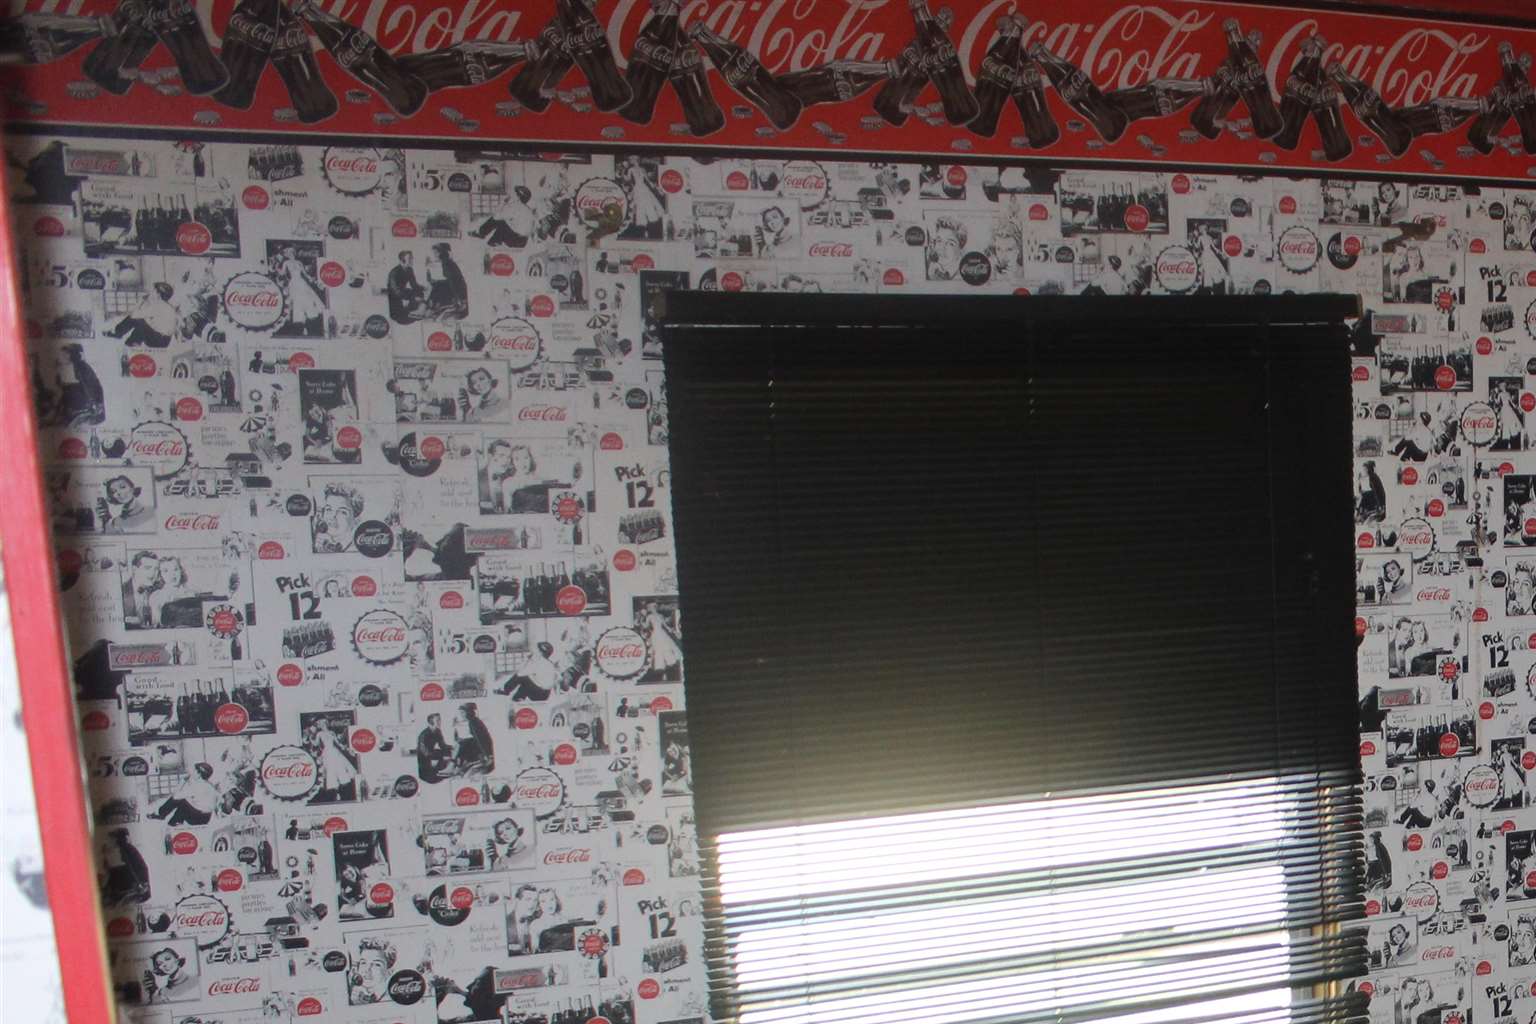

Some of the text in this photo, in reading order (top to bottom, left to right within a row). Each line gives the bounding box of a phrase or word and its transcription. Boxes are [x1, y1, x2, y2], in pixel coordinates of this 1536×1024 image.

[606, 0, 886, 72] Cca-Cola
[959, 0, 1214, 94] Cca-Cola
[1266, 19, 1490, 108] Cca-Cola
[326, 160, 377, 173] Coca-Cola
[785, 176, 825, 191] Coca-Cola
[808, 244, 854, 256] Coca-Cola
[224, 292, 279, 308] Coca-Cola
[518, 408, 568, 421] Coca-Cola
[133, 440, 183, 456] Coca-Cola
[615, 464, 646, 482] Pick
[626, 481, 654, 508] 12
[164, 516, 219, 530] Coca-Cola
[358, 532, 391, 545] Coca-Cola
[276, 573, 311, 593] Pick
[289, 591, 321, 620] 12
[355, 627, 406, 642] Coca-Cola
[1482, 633, 1505, 649] Pick
[597, 646, 642, 658] Coca-Cola
[1490, 645, 1509, 668] 12
[263, 764, 312, 778] Coca-Cola
[517, 784, 560, 799] Coca-Cola
[544, 848, 592, 864] Coca-Cola
[637, 896, 668, 916] Pick
[182, 912, 224, 927] Coca-Cola
[649, 912, 676, 939] 12
[208, 978, 260, 993] Coca-Cola
[390, 980, 421, 993] Coca-Cola
[1486, 985, 1507, 999] Pick
[1493, 996, 1512, 1018] 12
